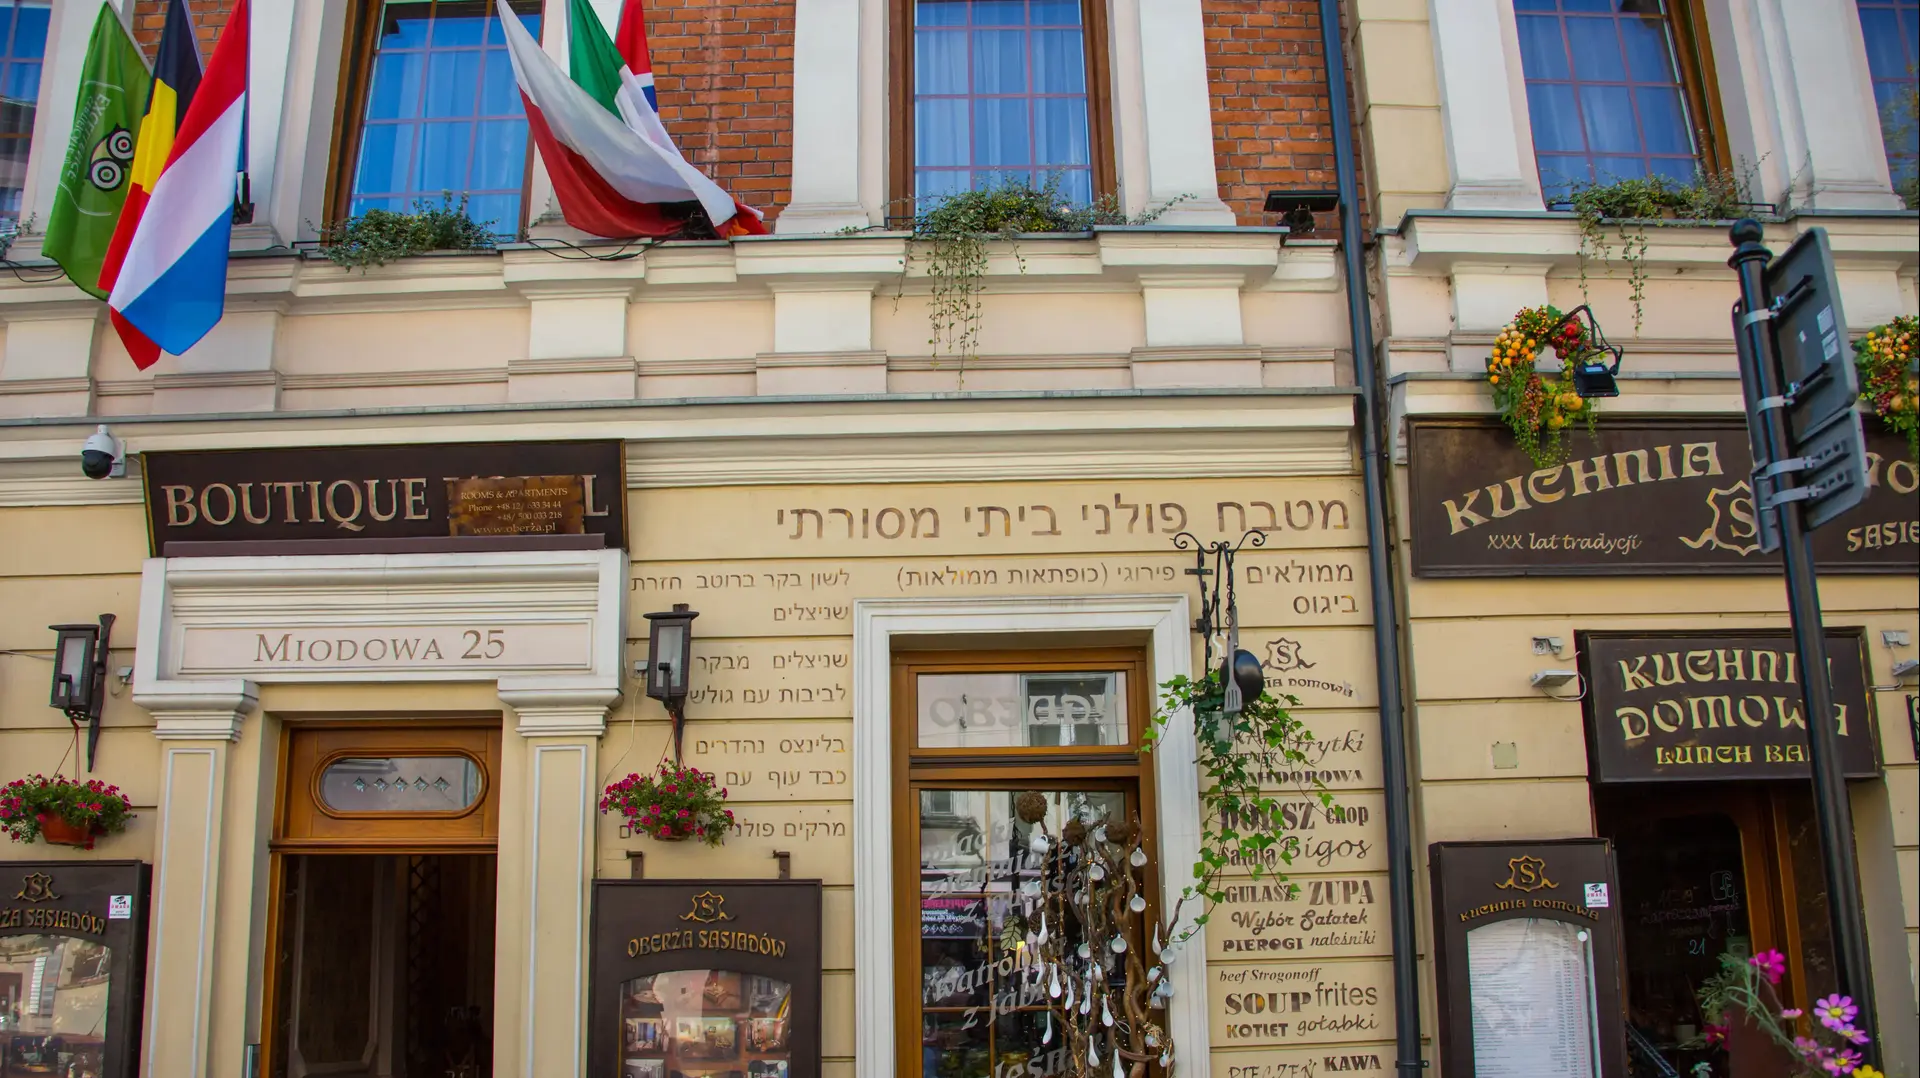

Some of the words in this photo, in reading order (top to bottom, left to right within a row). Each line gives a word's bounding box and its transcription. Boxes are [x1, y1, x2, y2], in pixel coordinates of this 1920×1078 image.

[461, 491, 494, 500] ROOMS
[496, 491, 503, 499] &
[505, 487, 568, 499] APARTMENTS
[1442, 441, 1723, 535] KUCHNIA
[161, 479, 430, 532] BOUTIQUE
[468, 504, 493, 513] Phone
[549, 511, 562, 519] 218
[1081, 493, 1188, 535] פולני
[776, 506, 941, 540] מסורתי
[964, 504, 1062, 538] ביתי
[1217, 499, 1350, 533] מטבח
[1488, 533, 1522, 550] XXX
[1529, 533, 1561, 550] lat
[1562, 533, 1643, 555] tradycji
[696, 574, 756, 590] ברוטב
[811, 568, 850, 591] לשון
[1117, 564, 1176, 583] פירוגי
[1246, 559, 1354, 585] ממולאים
[630, 574, 682, 592] חזרת
[763, 575, 801, 592] בקר
[773, 602, 849, 622] שניצלים
[1292, 593, 1359, 615] ביגוס
[461, 629, 505, 660] 25
[695, 655, 750, 674] מבקר
[773, 650, 848, 669] שניצלים
[1617, 649, 1831, 692] KUCHNI
[689, 685, 734, 704] גולש
[743, 688, 770, 703] עם
[778, 683, 846, 703] לביבות
[695, 739, 765, 755] נהדרים
[779, 734, 846, 753] בלינצס
[1656, 745, 1752, 765] LUNCH
[1765, 744, 1810, 763] BA
[725, 770, 752, 786] עם
[767, 770, 800, 789] עוף
[808, 769, 847, 785] כבד
[783, 821, 846, 841] מרקים
[1520, 863, 1535, 884] S
[31, 878, 43, 896] S
[1308, 880, 1376, 906] ZUPA
[701, 898, 715, 916] S
[1460, 899, 1527, 922] KUCHNIA
[1532, 899, 1600, 921] DOMOWA
[1231, 911, 1295, 936] Wybór
[627, 928, 693, 958] OBERŻA
[1222, 937, 1304, 952] PIEROGI
[1310, 930, 1377, 947] naleśniki
[1219, 969, 1249, 985] beef
[1250, 967, 1322, 984] Strogonoff
[1225, 991, 1312, 1017] SOUP
[1315, 982, 1379, 1007] frites
[1296, 1013, 1380, 1036] gołąbki
[1323, 1055, 1382, 1072] KAWA
